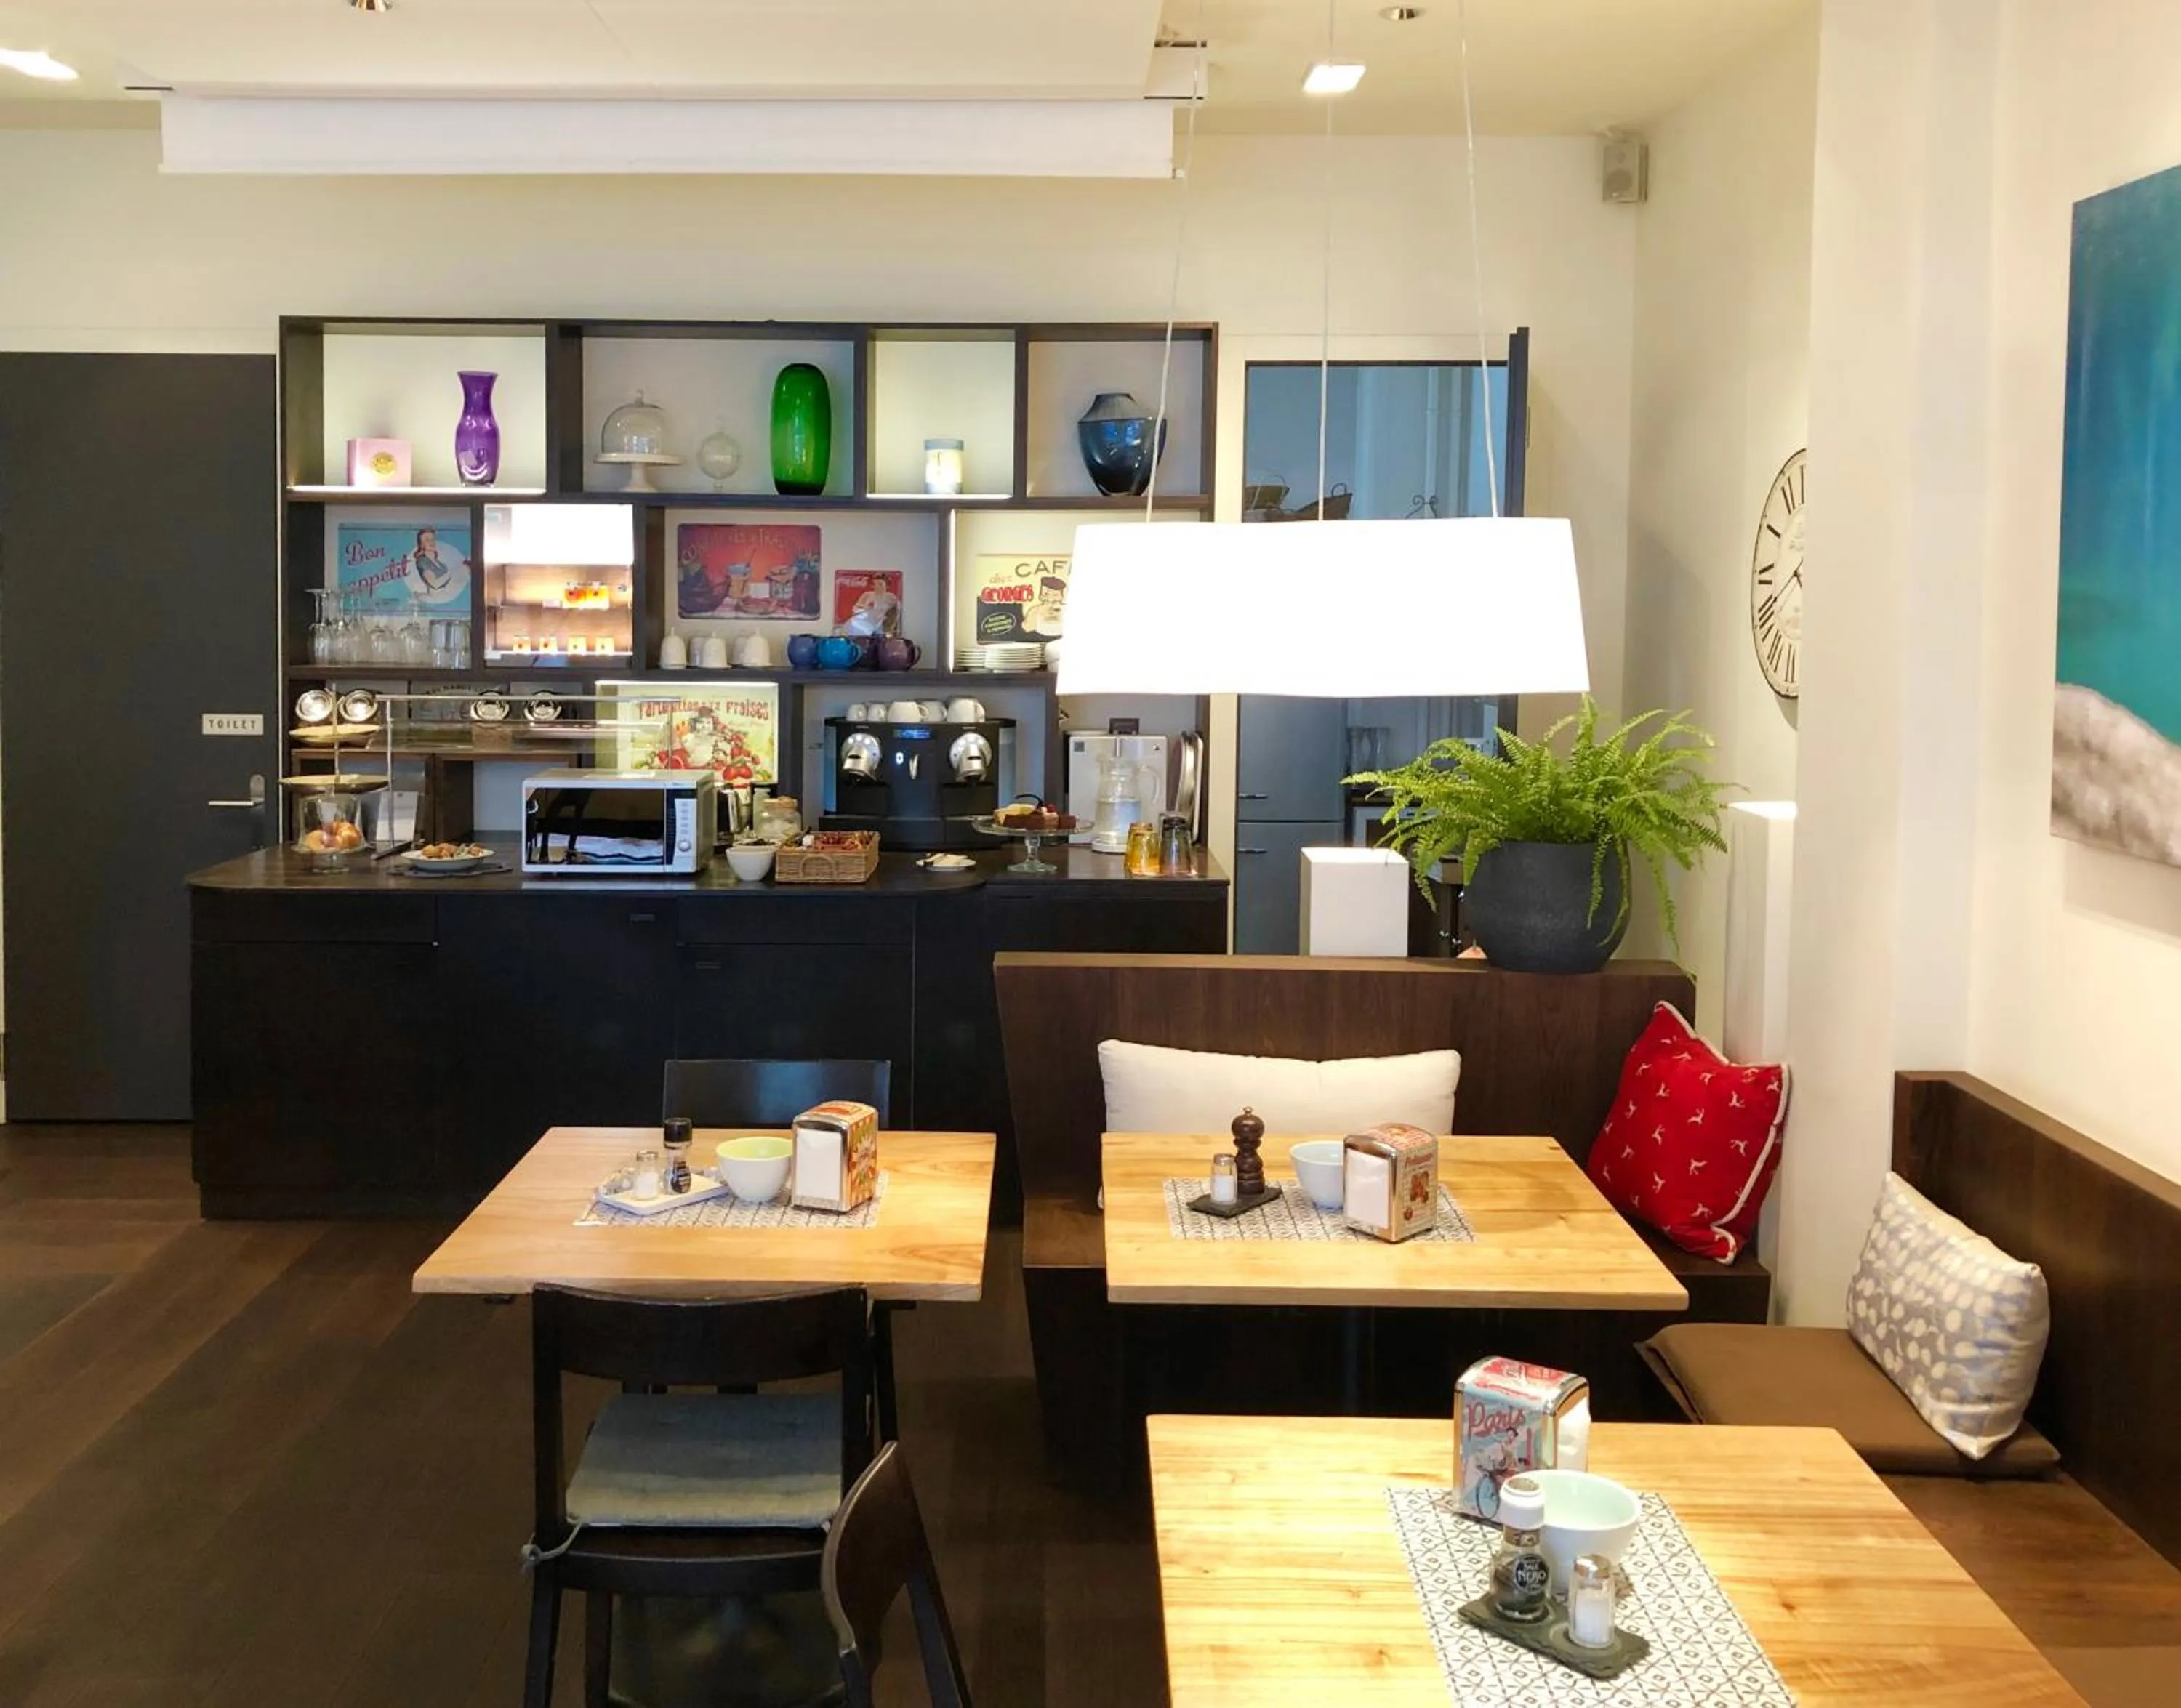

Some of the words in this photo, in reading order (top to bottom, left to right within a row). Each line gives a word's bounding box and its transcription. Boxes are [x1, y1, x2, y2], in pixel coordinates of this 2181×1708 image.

[345, 540, 385, 565] Bon
[1015, 560, 1072, 578] CAF
[726, 698, 769, 720] Fraises
[209, 719, 256, 730] TOILET
[1465, 1401, 1526, 1442] Paris
